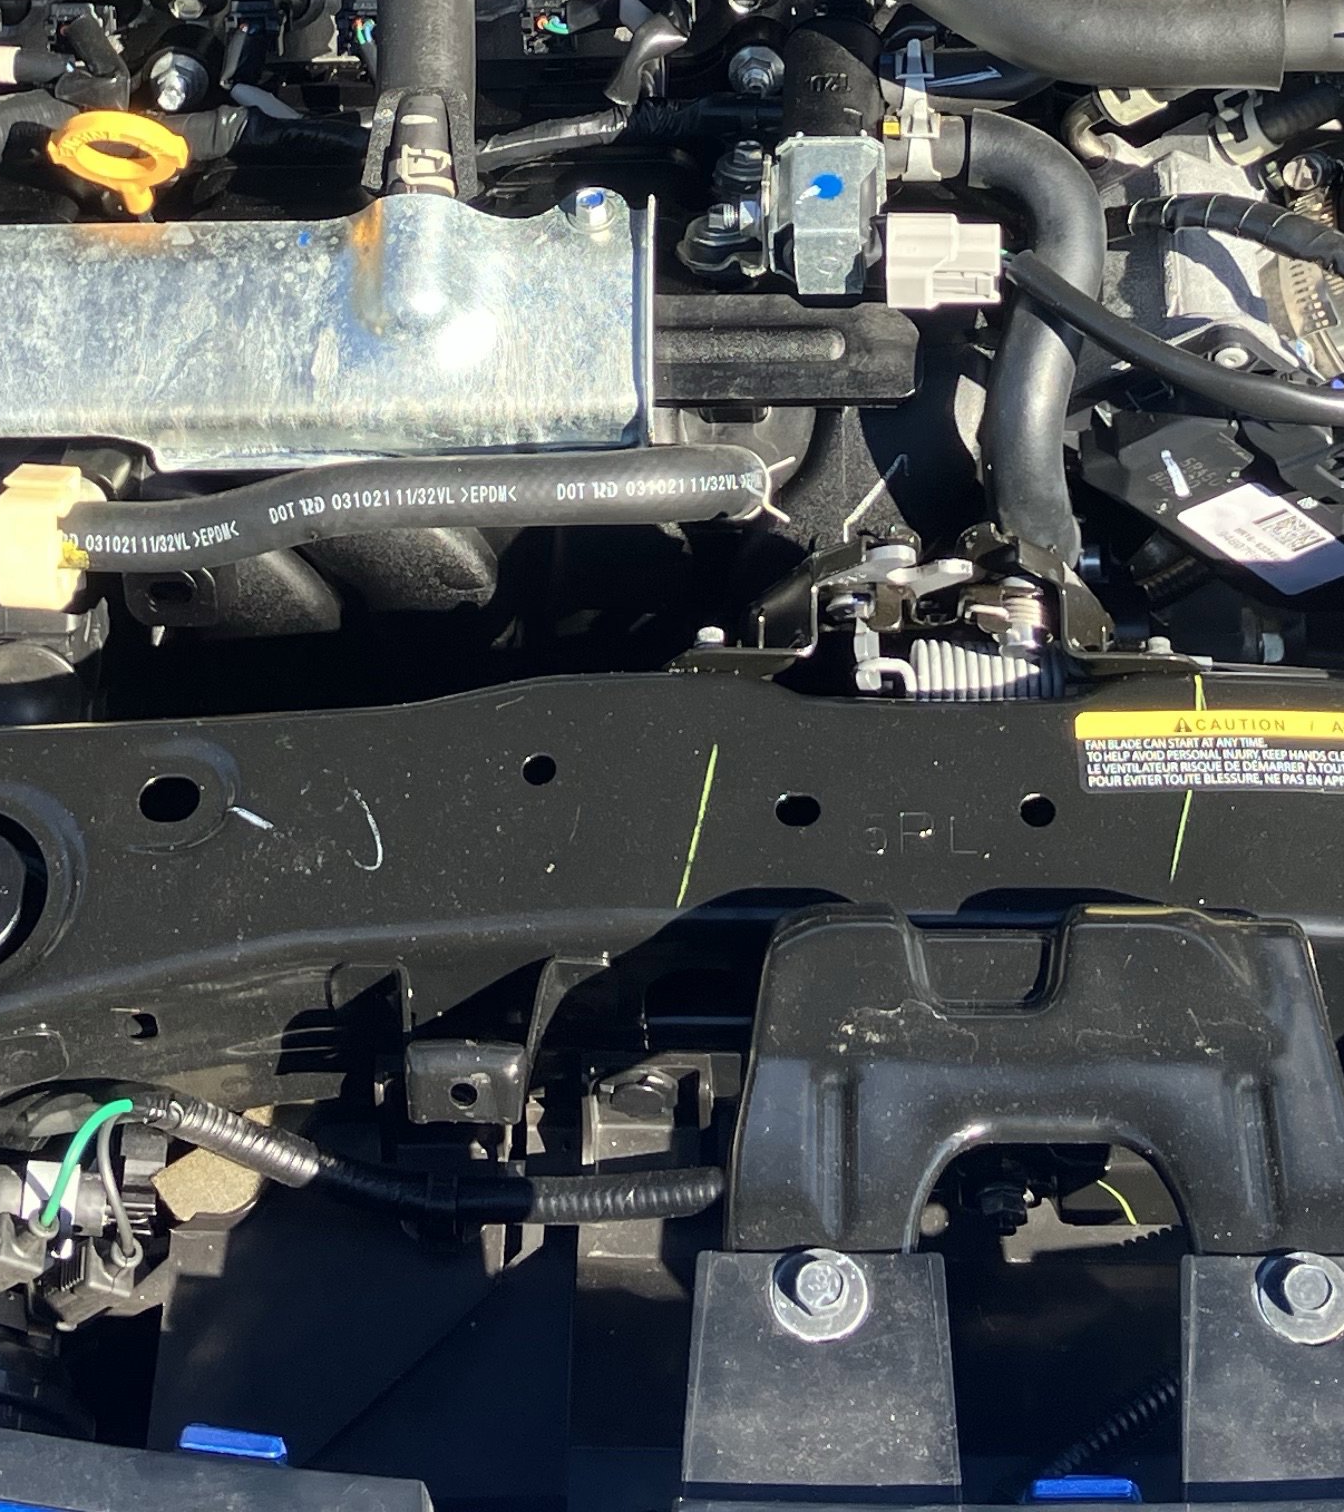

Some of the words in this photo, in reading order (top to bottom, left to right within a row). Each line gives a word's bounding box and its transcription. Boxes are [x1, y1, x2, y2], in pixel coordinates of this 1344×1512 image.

[557, 482, 586, 501] DOT
[626, 478, 685, 497] 031021
[690, 474, 740, 493] 11/32VL
[268, 502, 295, 524] DOT
[331, 489, 391, 511] 031021
[396, 486, 455, 505] 11/32VL
[85, 534, 137, 553] 031021
[141, 532, 191, 553] 11/32VL
[1196, 719, 1286, 732] CAUTION
[1085, 739, 1106, 750] FAN
[1108, 739, 1142, 750] BLADE
[1143, 739, 1167, 749] CAN
[1168, 739, 1200, 749] START
[1201, 738, 1214, 748] AT
[1216, 738, 1239, 748] ANY
[1240, 738, 1268, 748] TIME.
[1086, 751, 1103, 762] TO
[1105, 751, 1131, 762] HELP
[1132, 751, 1165, 761] AVOID
[1167, 750, 1221, 761] PERSONAL
[1222, 750, 1260, 762] INJURY,
[1263, 750, 1288, 761] KEEP
[1290, 751, 1327, 762] HANDS
[1087, 763, 1102, 775] LE
[1103, 762, 1178, 775] VENTILATEUR
[1180, 761, 1223, 773] RISQUE
[1224, 761, 1240, 772] DE
[1242, 759, 1305, 772] DÉMARRER
[1089, 775, 1122, 787] POUR
[1124, 773, 1163, 786] ÉVITER
[1163, 773, 1202, 785] TOUTE
[1203, 773, 1263, 786] BLESSURE,
[1264, 774, 1281, 785] NE
[1282, 774, 1305, 785] PAS
[1306, 774, 1322, 786] EN
